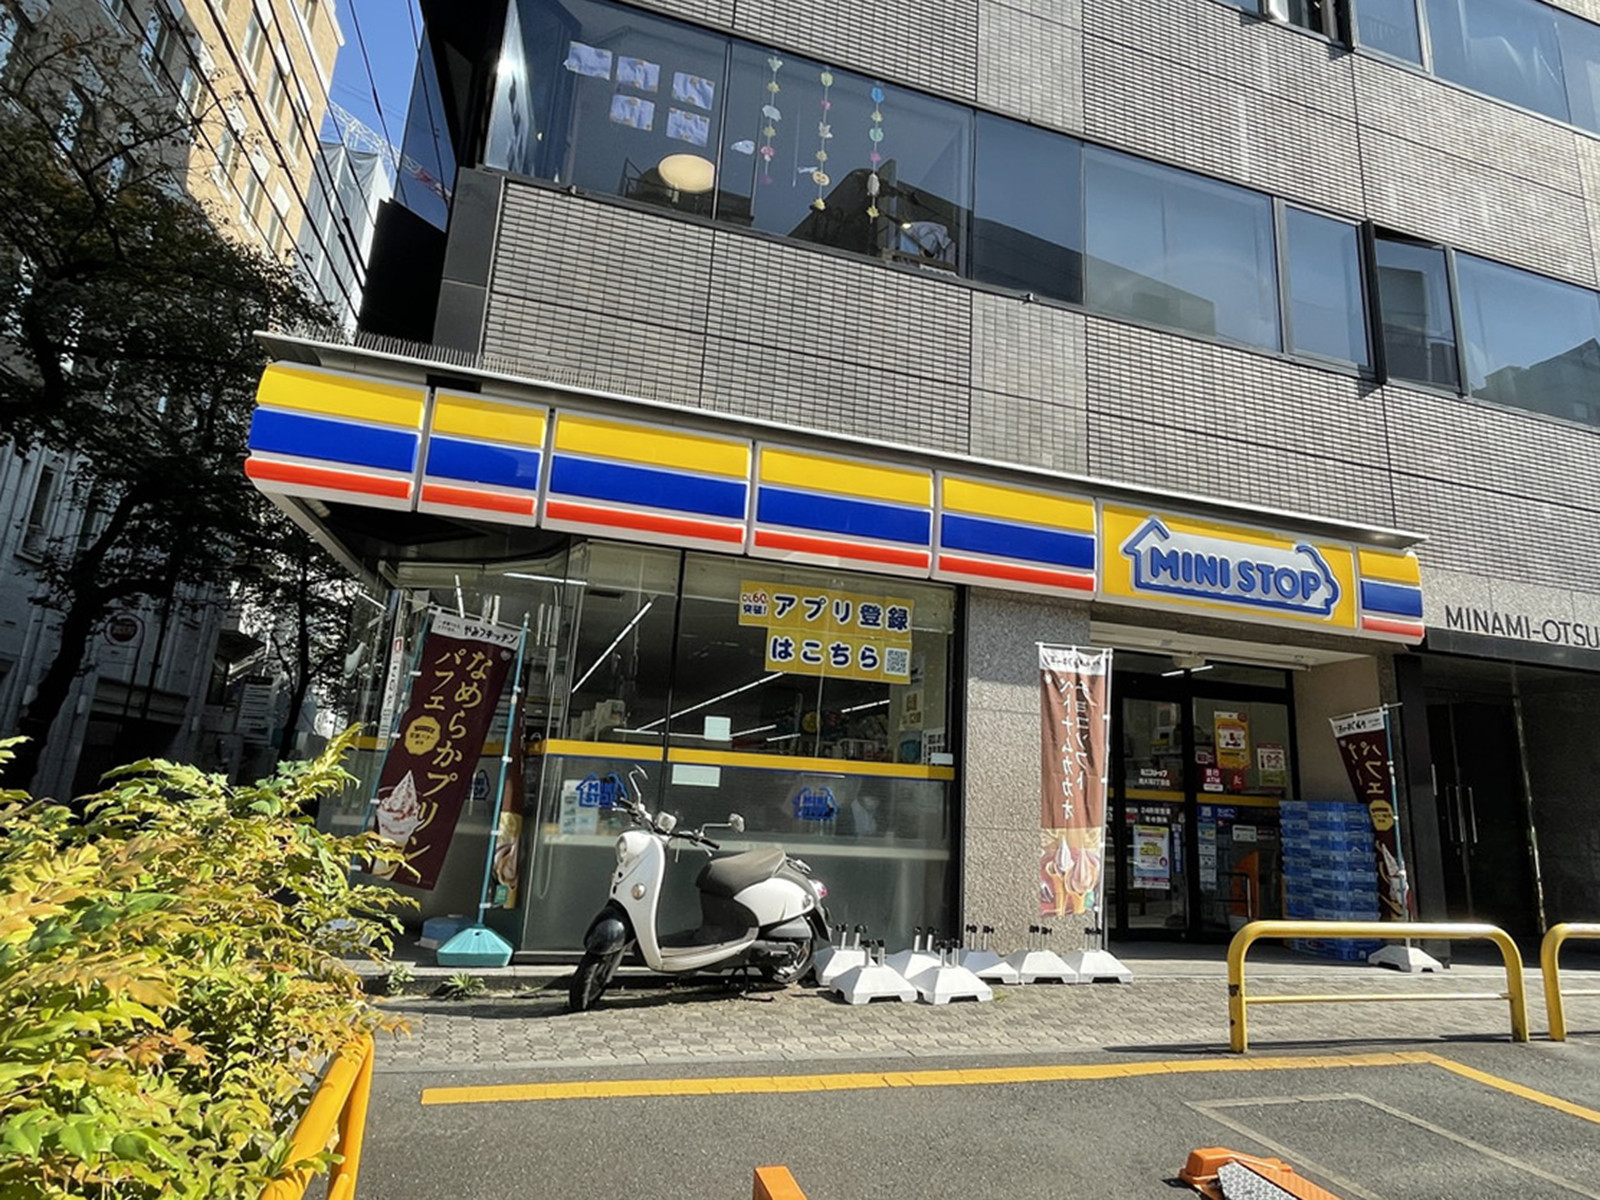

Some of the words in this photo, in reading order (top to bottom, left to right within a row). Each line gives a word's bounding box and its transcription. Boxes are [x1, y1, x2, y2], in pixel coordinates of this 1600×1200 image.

[1150, 547, 1231, 589] MINI
[1237, 560, 1322, 601] STOP
[774, 594, 909, 631] アプリ登録
[1445, 604, 1600, 648] MINAMI-OTSU
[771, 637, 878, 668] はこちら
[423, 648, 467, 710] パフェ
[404, 650, 493, 859] なめらかプリン
